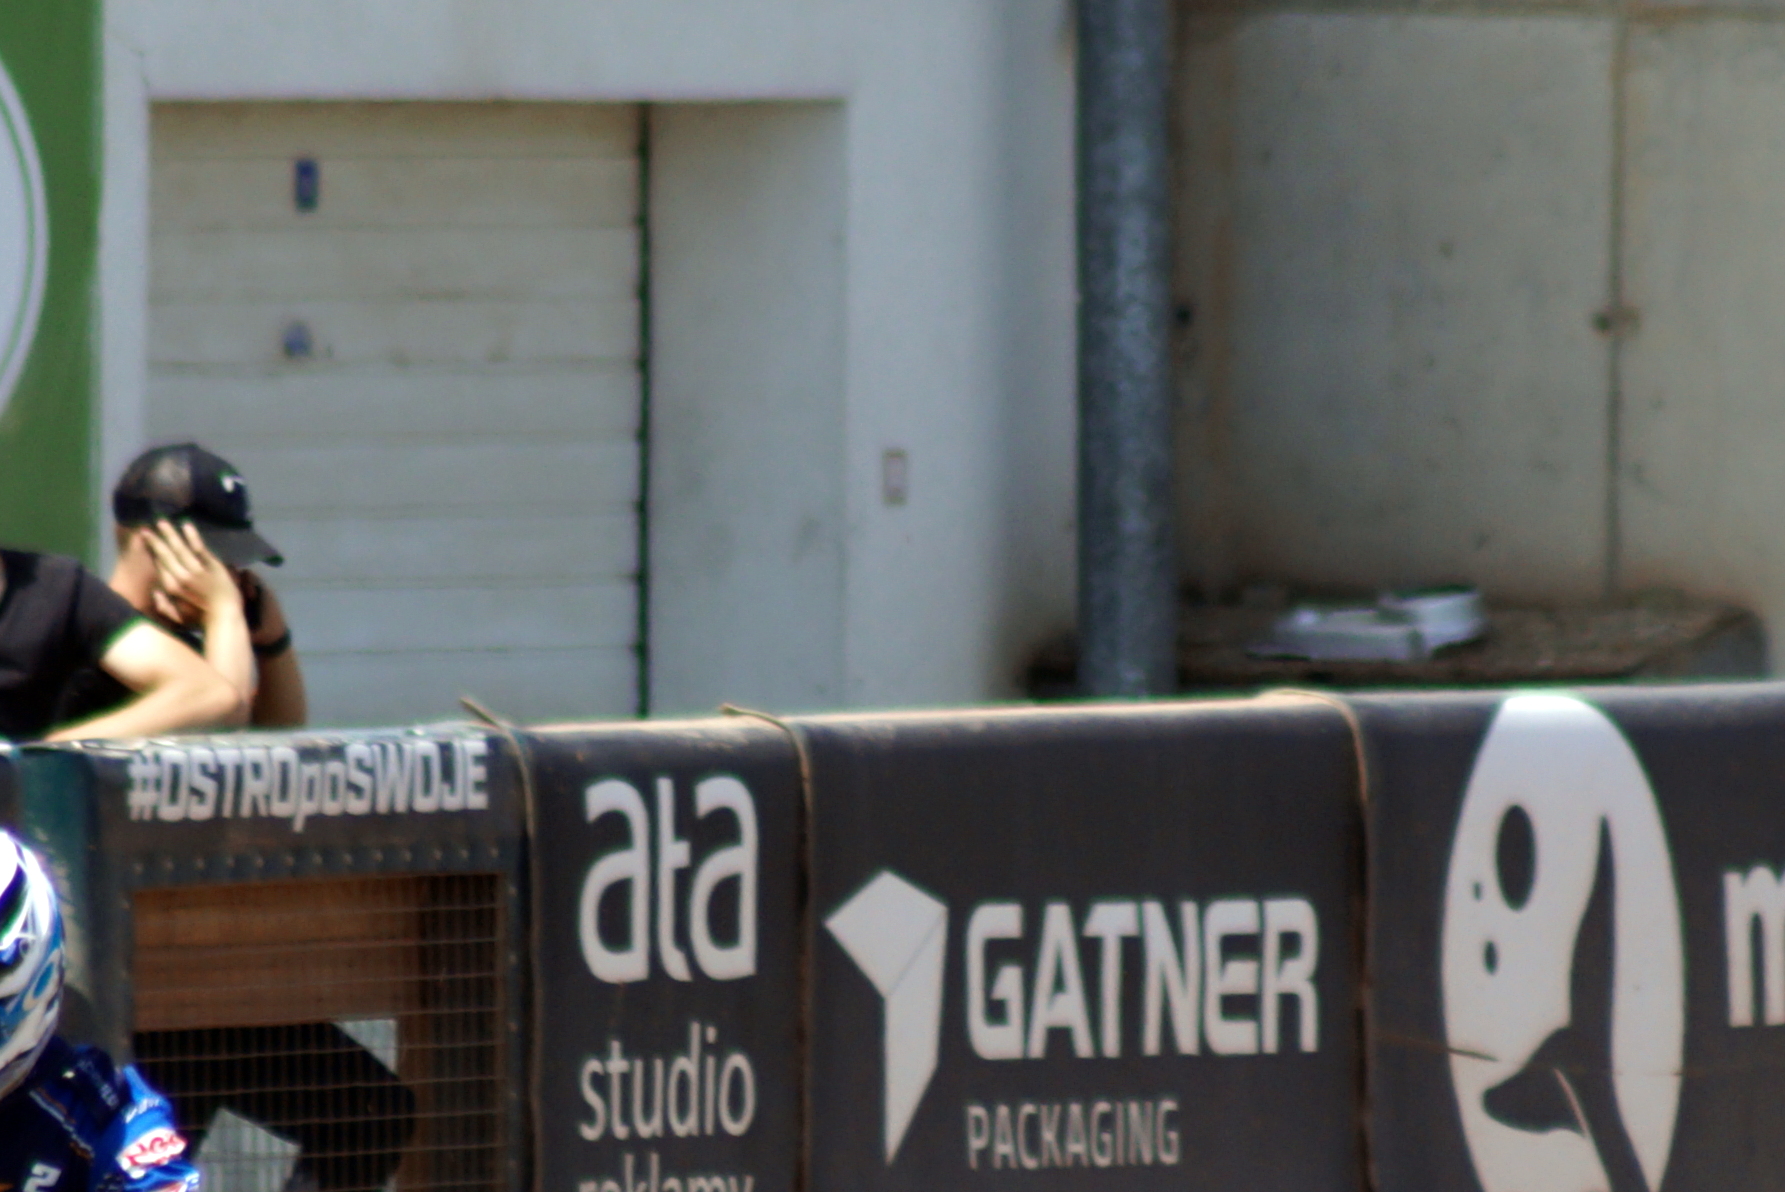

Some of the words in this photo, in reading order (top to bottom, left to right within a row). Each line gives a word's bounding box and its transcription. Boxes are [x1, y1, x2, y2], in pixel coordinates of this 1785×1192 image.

[578, 775, 759, 984] ata
[965, 896, 1320, 1061] GATNER
[578, 1021, 757, 1143] studio
[965, 1099, 1181, 1171] PACKAGING
